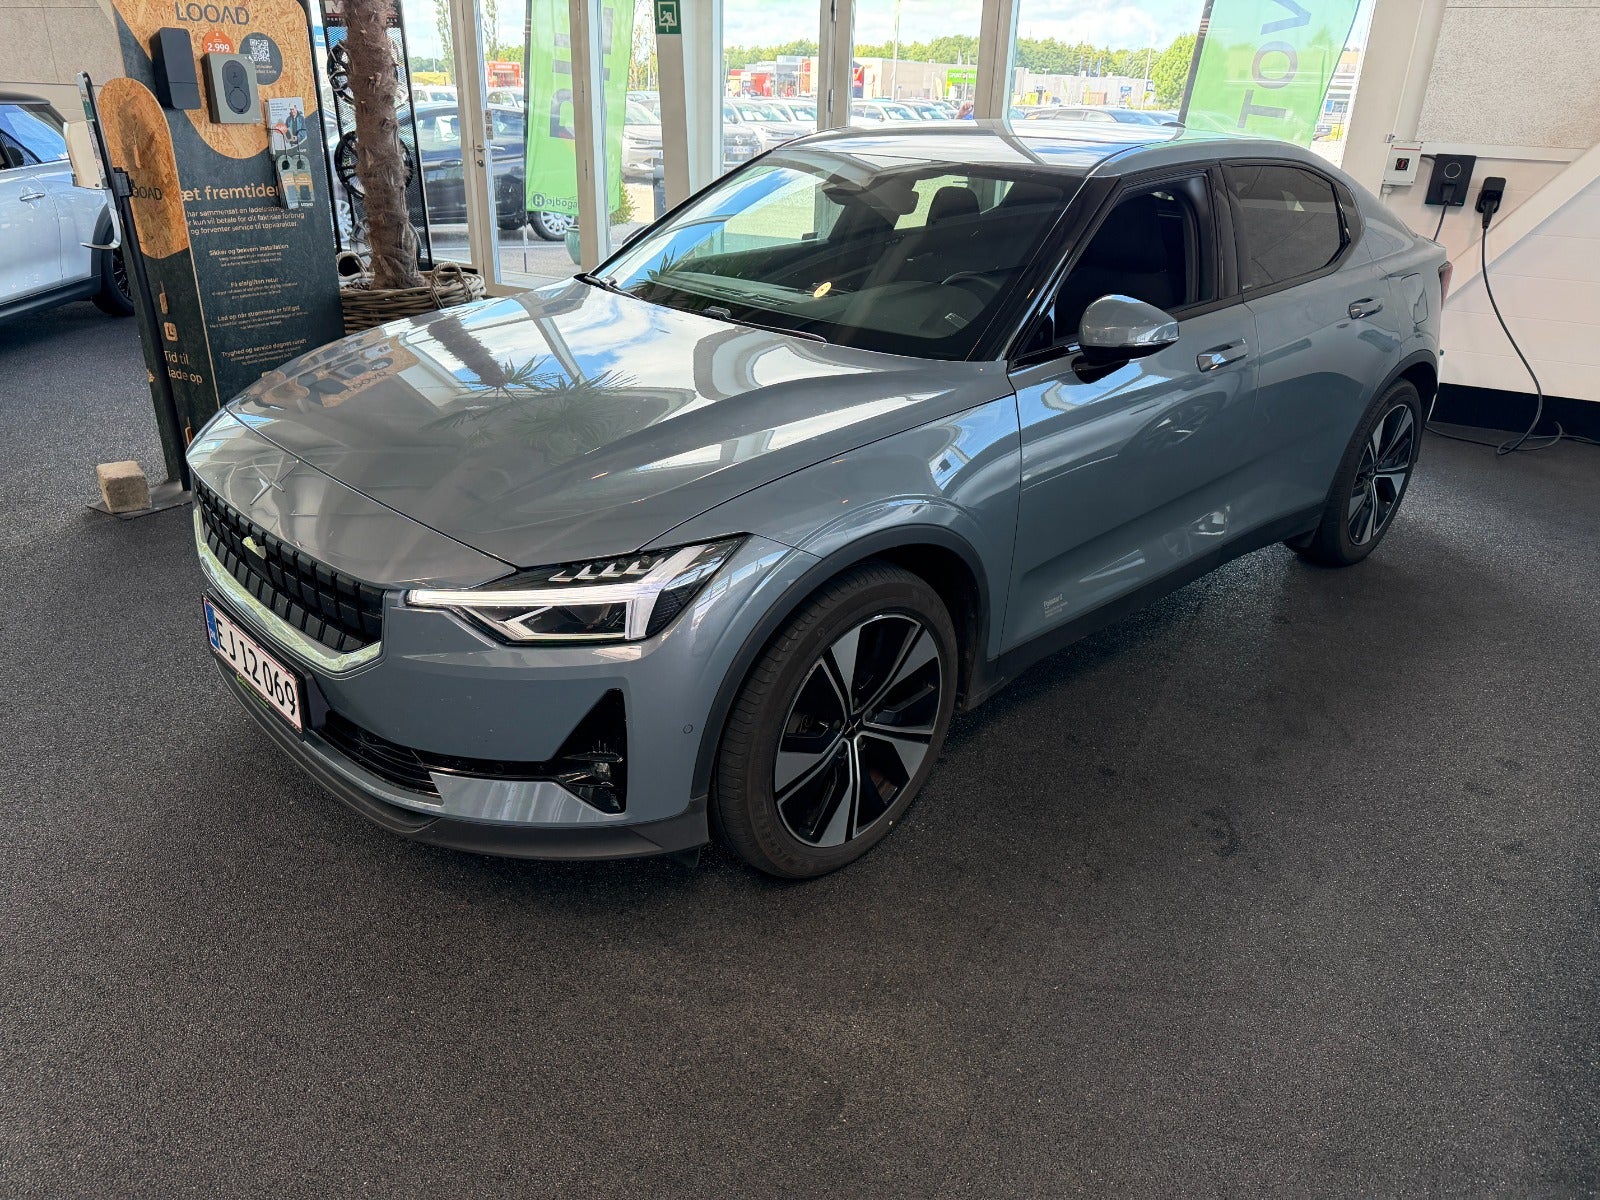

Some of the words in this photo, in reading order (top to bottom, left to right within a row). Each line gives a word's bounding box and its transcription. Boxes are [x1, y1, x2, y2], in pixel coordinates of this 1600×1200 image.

[175, 2, 250, 25] LOOAD
[207, 43, 230, 52] 2.999
[130, 186, 163, 201] OOAD
[181, 187, 202, 202] æt
[205, 182, 279, 200] fremtide
[164, 350, 178, 363] Tid
[180, 353, 189, 365] til
[189, 373, 203, 385] op
[215, 617, 237, 661] EJ
